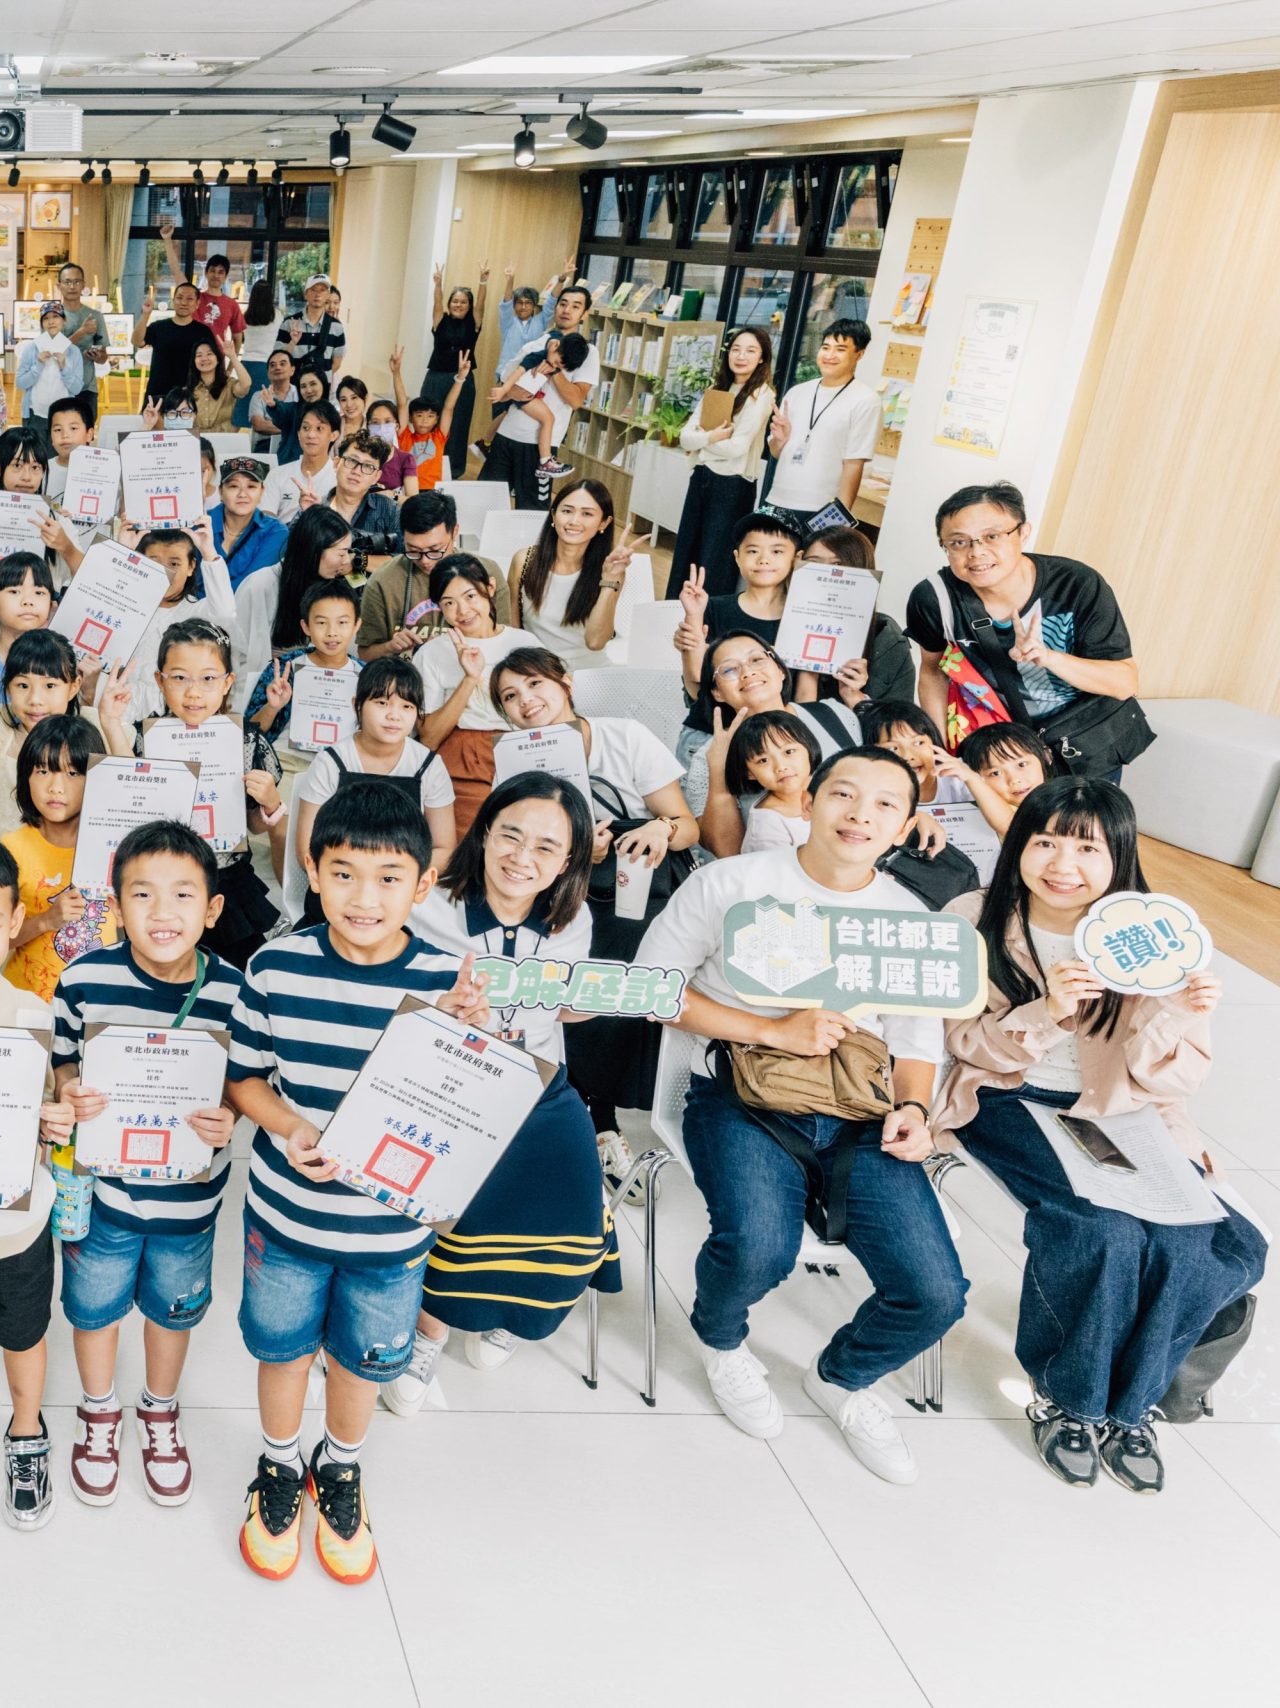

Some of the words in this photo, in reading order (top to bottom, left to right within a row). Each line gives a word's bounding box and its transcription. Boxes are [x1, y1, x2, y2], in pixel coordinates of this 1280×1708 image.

[116, 773, 168, 785] 臺北市政府獎狀
[834, 915, 961, 952] 台北都更
[1103, 917, 1186, 974] 讚!
[834, 953, 961, 999] 解壓說
[124, 1045, 190, 1057] 臺北市政府獎狀
[433, 1038, 504, 1080] 臺北市政府獎狀
